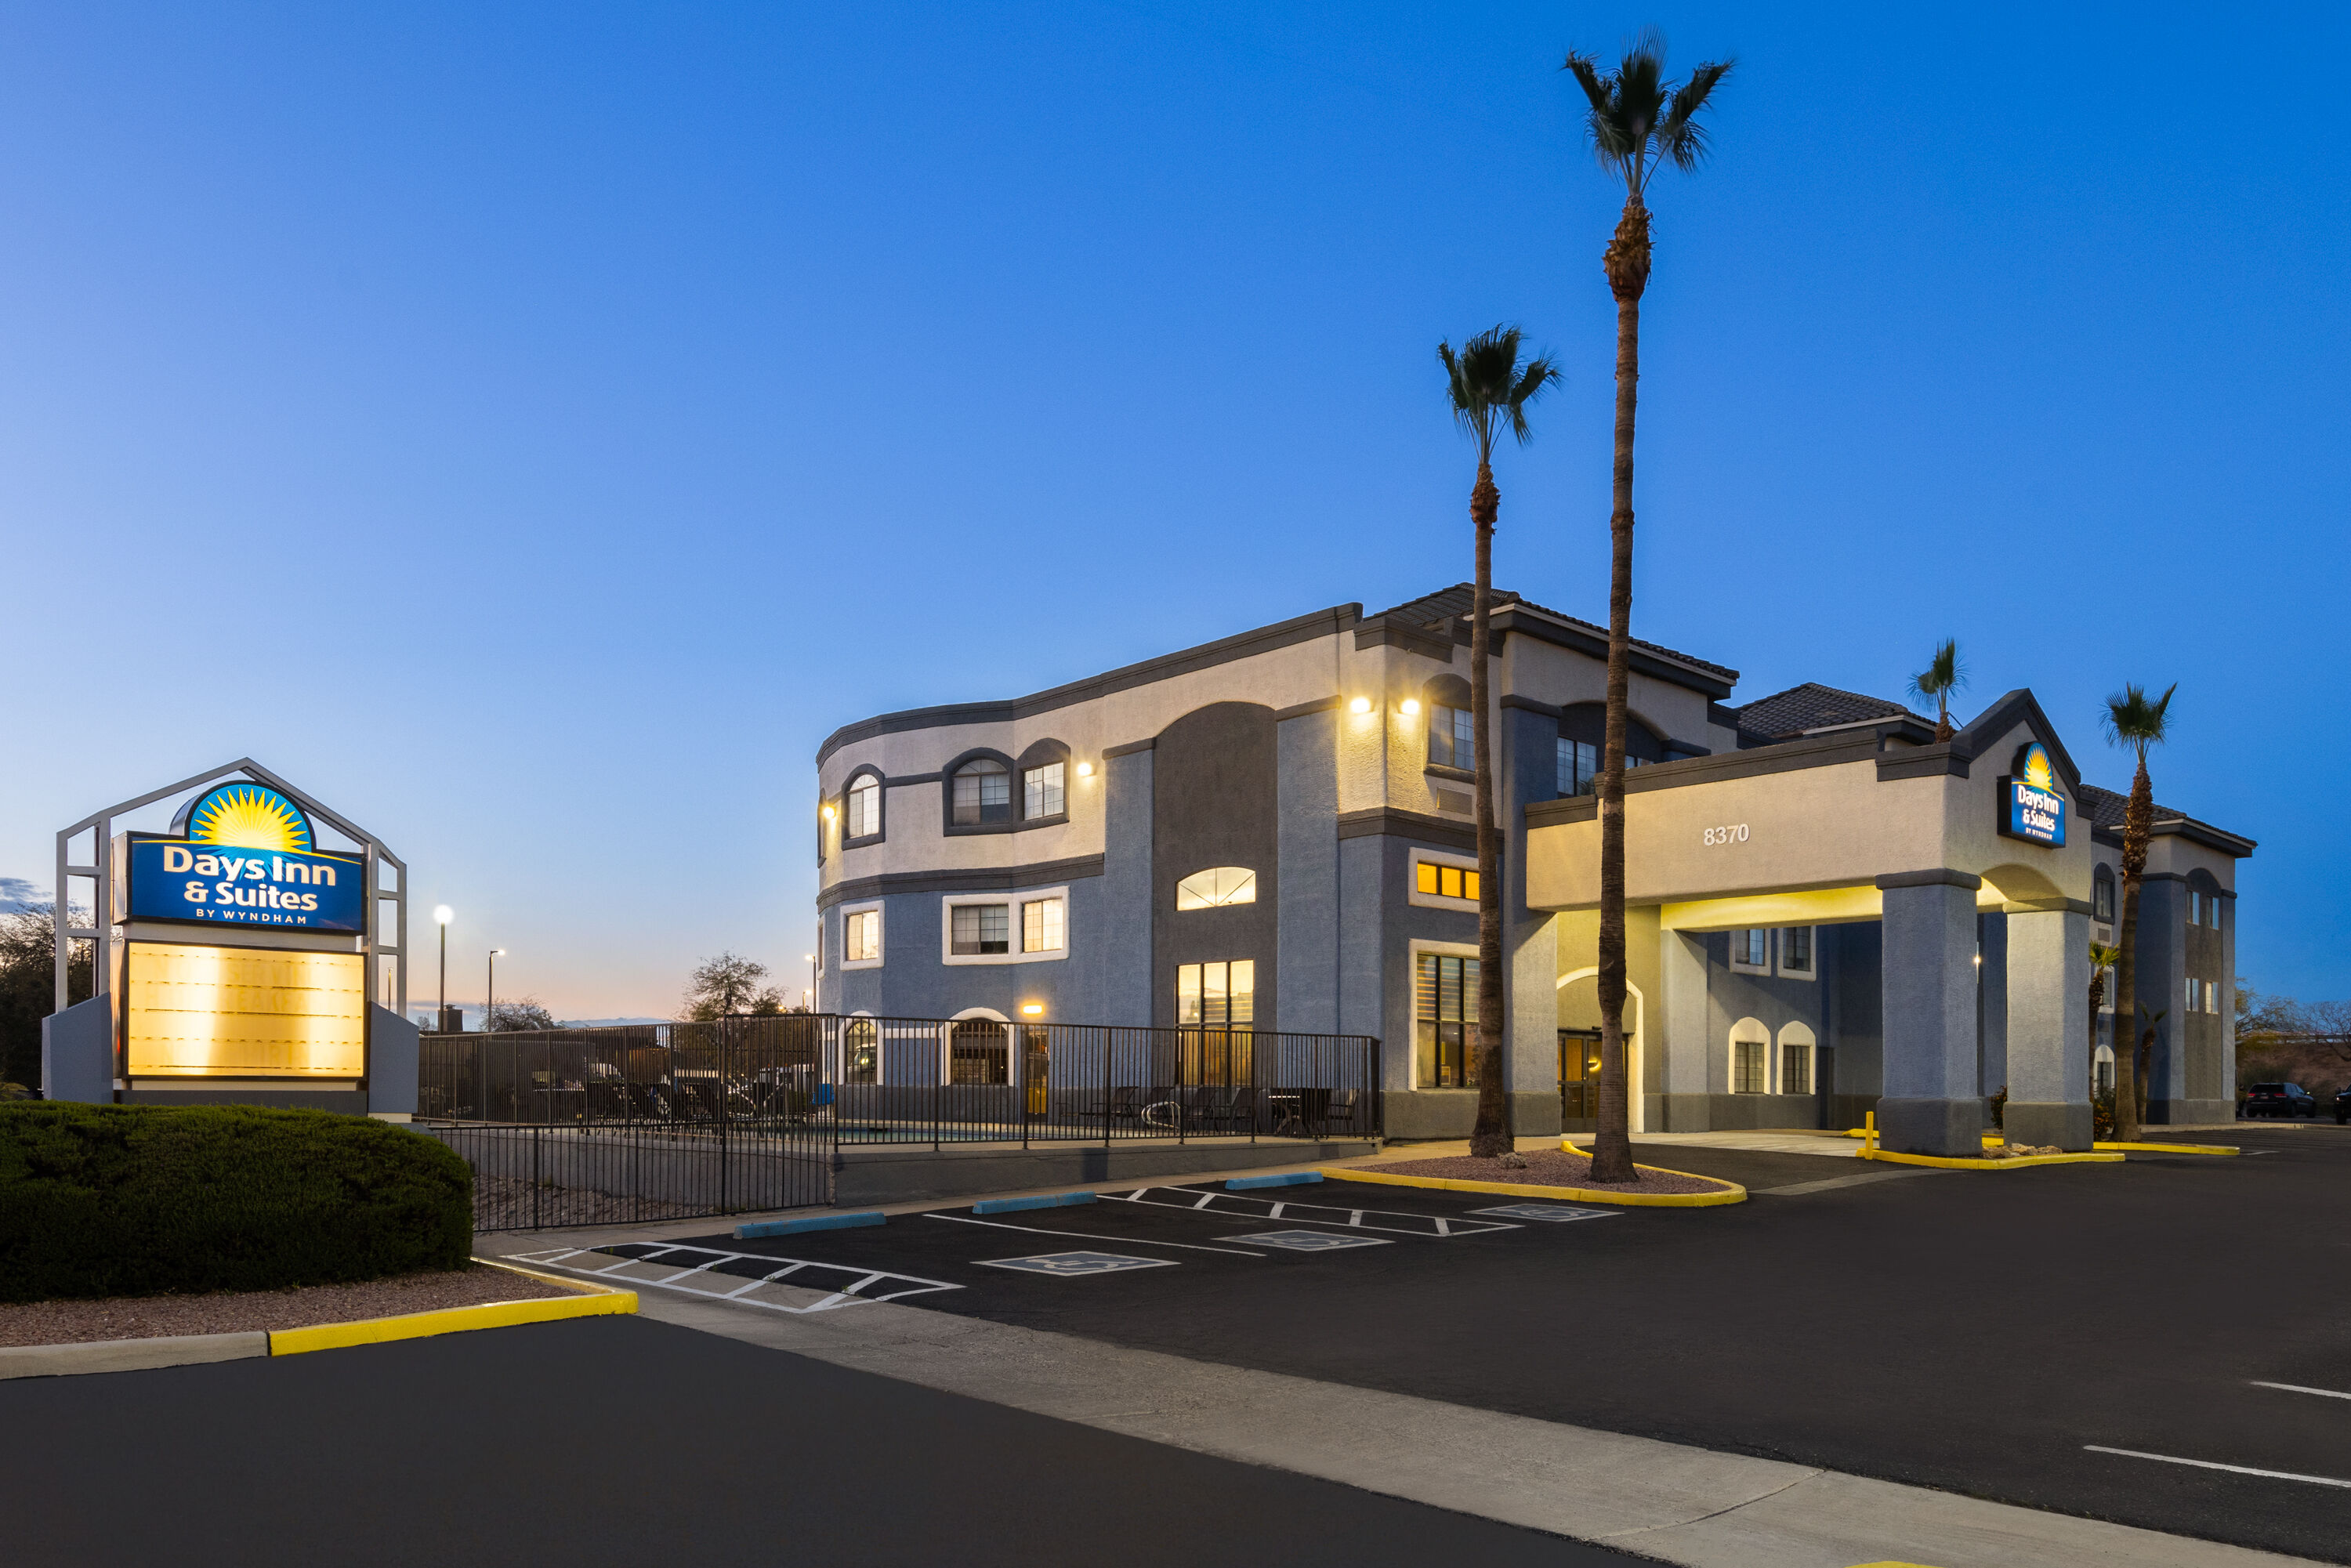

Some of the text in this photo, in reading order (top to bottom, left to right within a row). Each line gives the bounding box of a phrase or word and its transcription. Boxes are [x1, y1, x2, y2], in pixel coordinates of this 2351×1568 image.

[2018, 784, 2059, 814] Days Inn
[2023, 808, 2055, 831] & Suites
[1704, 824, 1749, 846] 8370
[163, 846, 336, 886] Days Inn
[183, 881, 318, 911] & Suites
[196, 908, 306, 925] BY WYNDHAM
